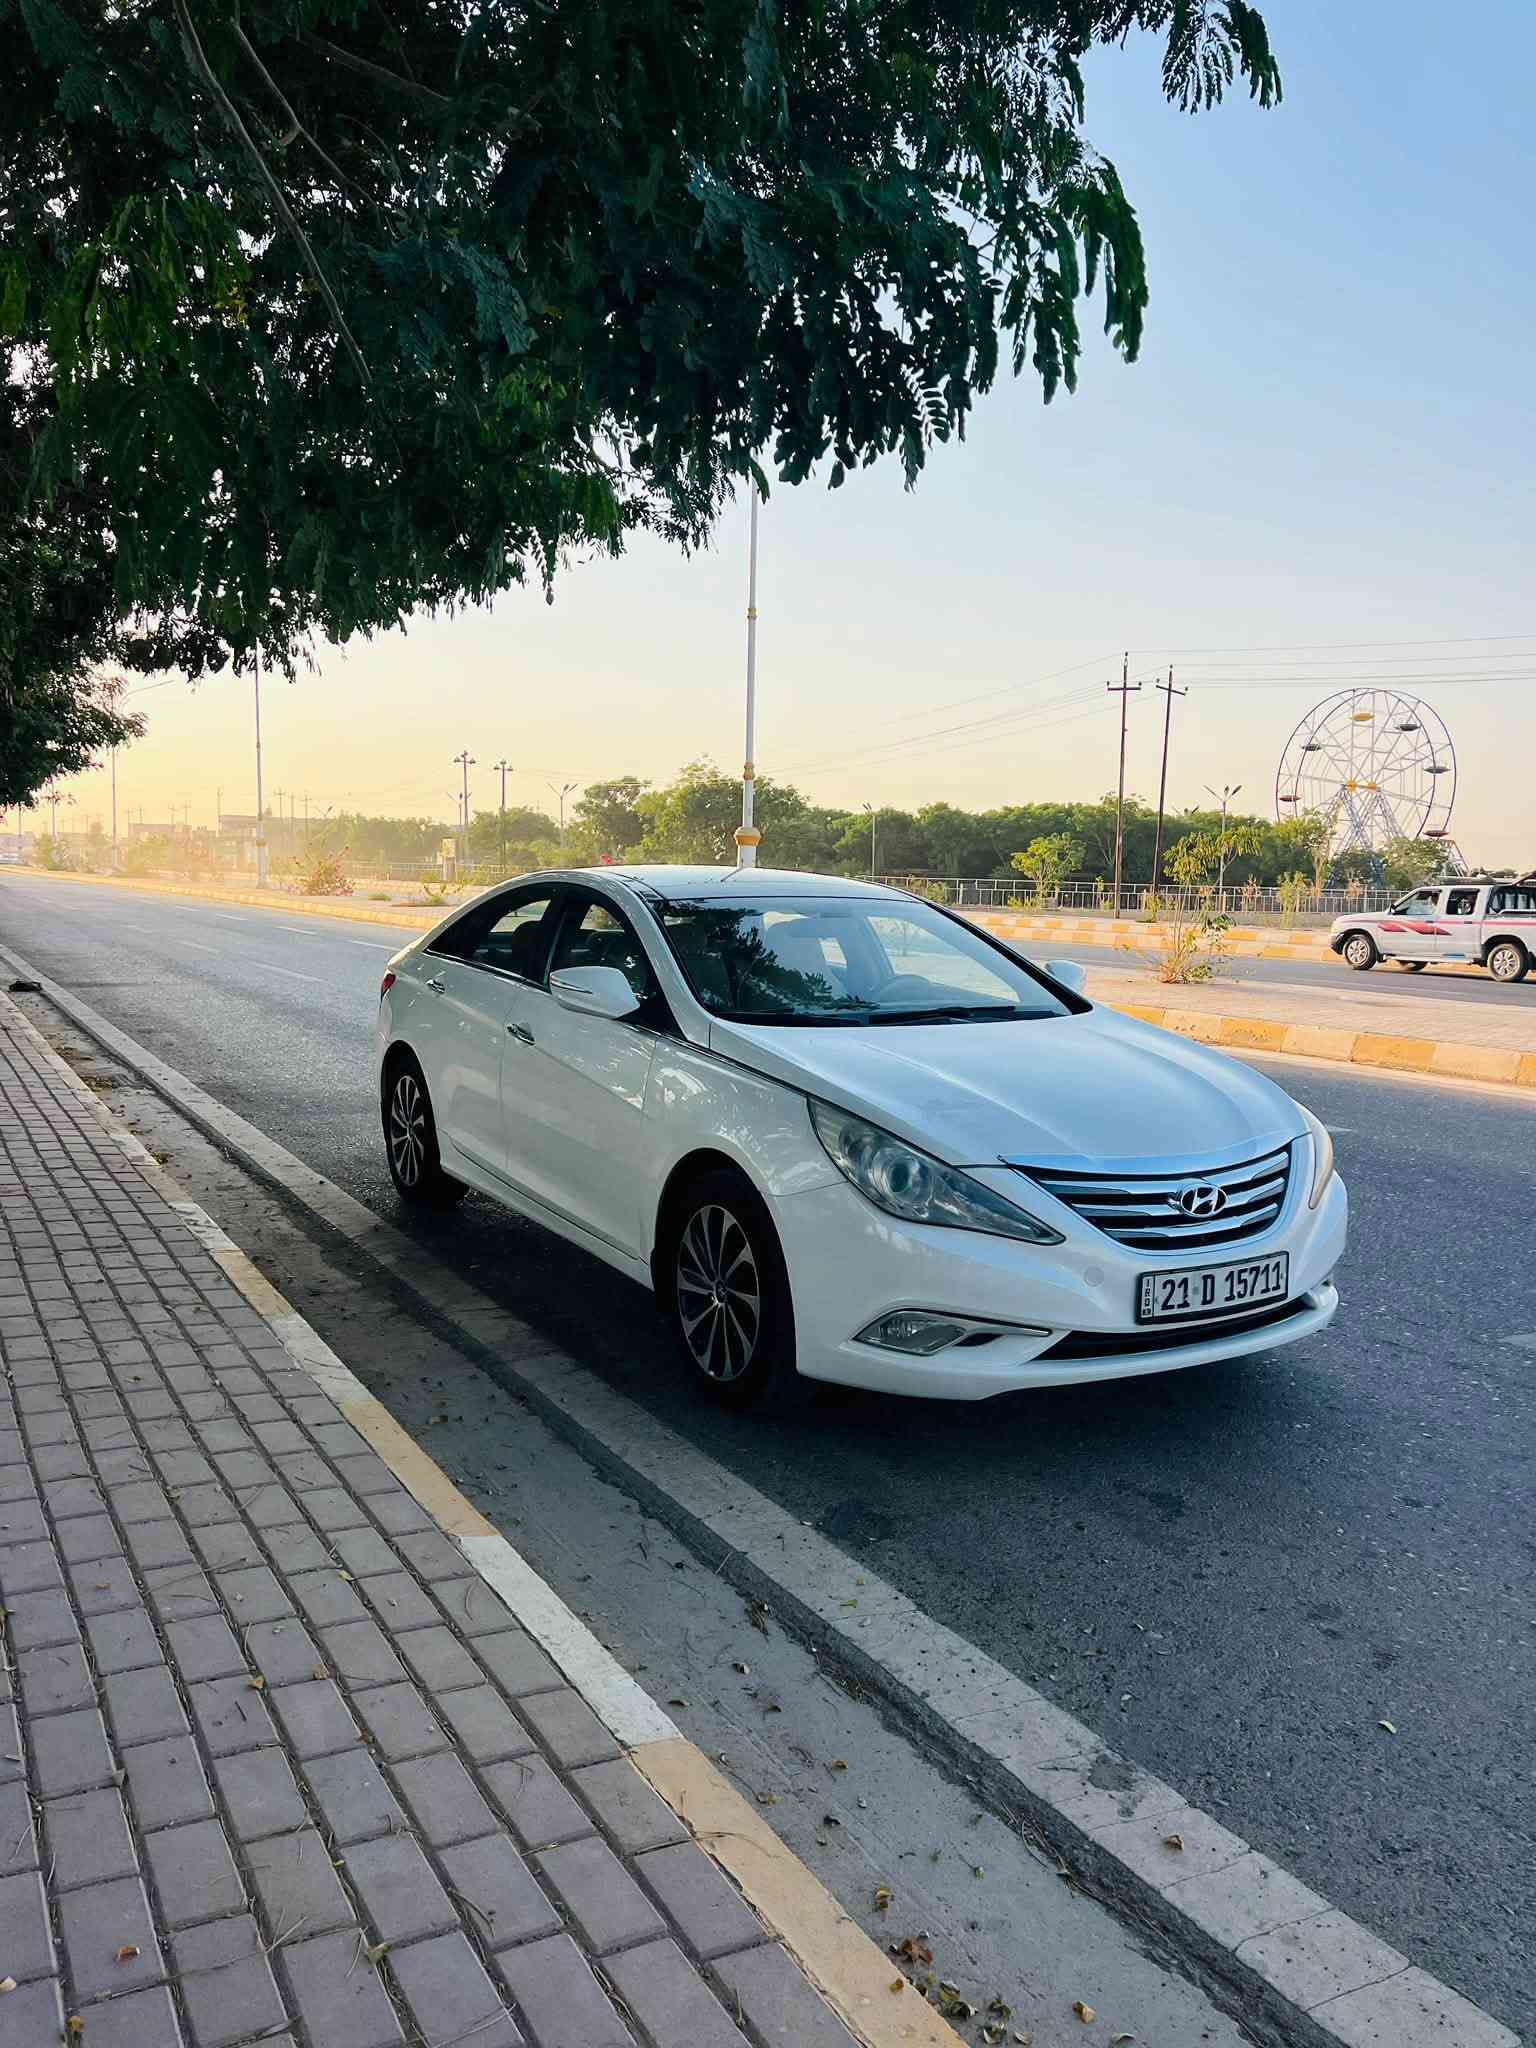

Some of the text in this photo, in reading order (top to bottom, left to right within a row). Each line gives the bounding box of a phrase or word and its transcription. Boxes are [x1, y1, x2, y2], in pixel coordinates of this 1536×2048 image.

[1161, 1261, 1281, 1310] 21 D 15711
